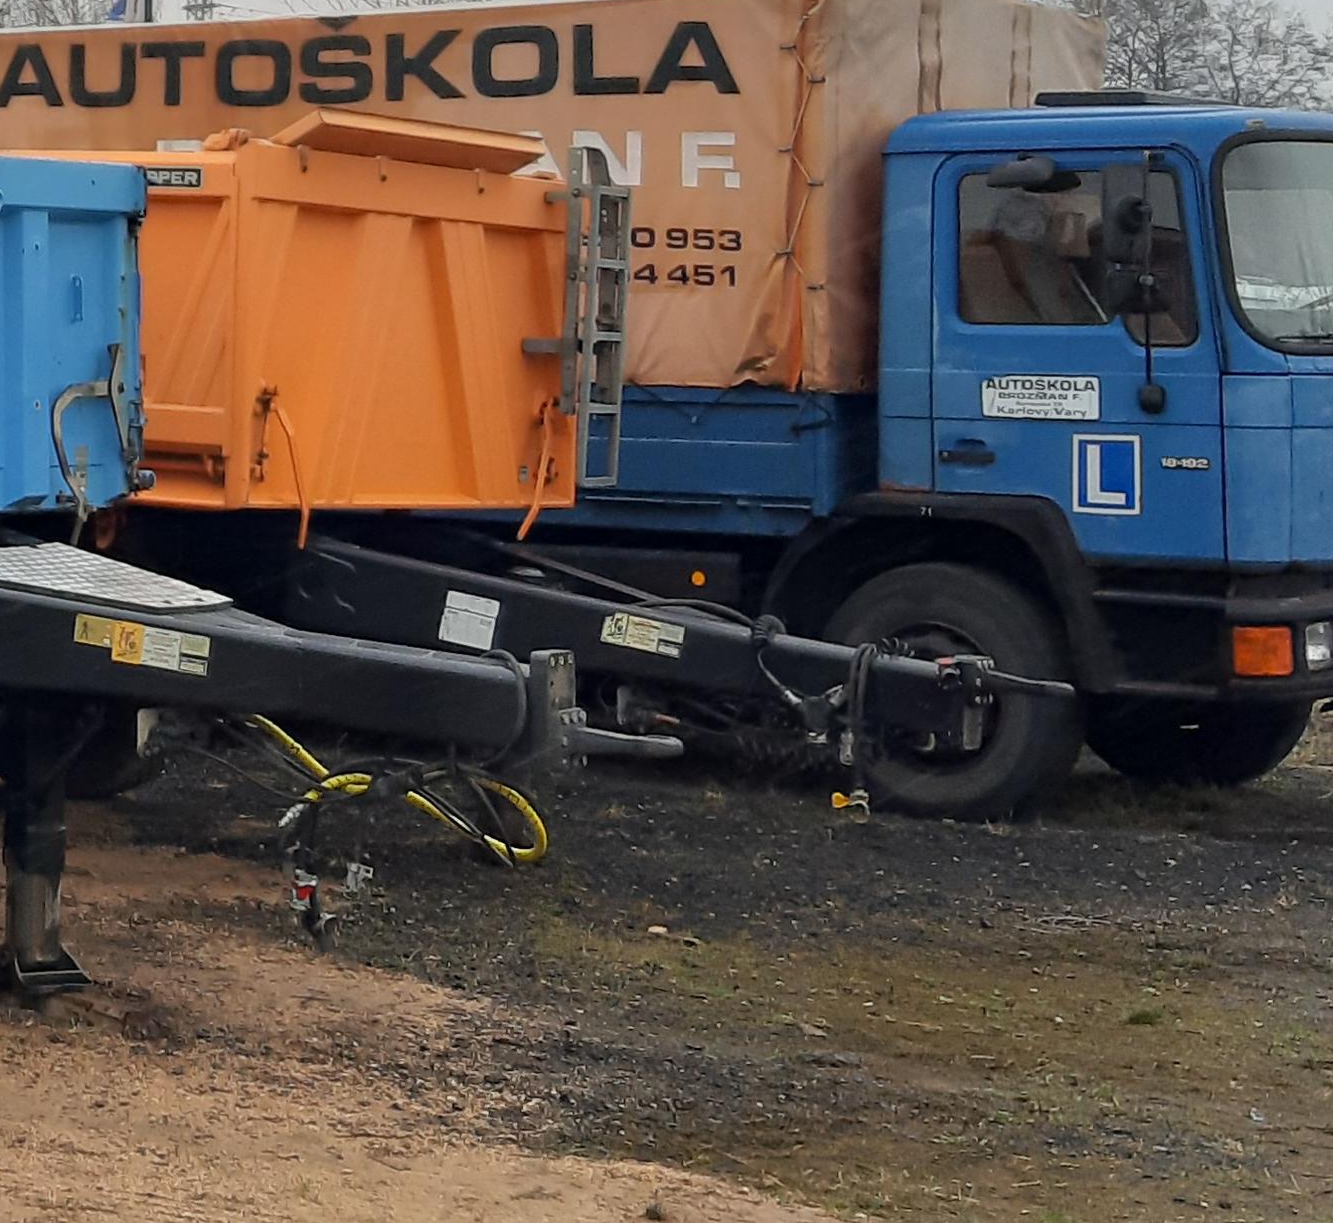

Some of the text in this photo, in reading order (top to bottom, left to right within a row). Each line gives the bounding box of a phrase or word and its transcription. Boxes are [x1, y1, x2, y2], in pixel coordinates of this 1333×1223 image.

[682, 131, 740, 188] F.
[665, 228, 742, 251] 953
[667, 265, 735, 287] 451
[1086, 444, 1126, 505] L
